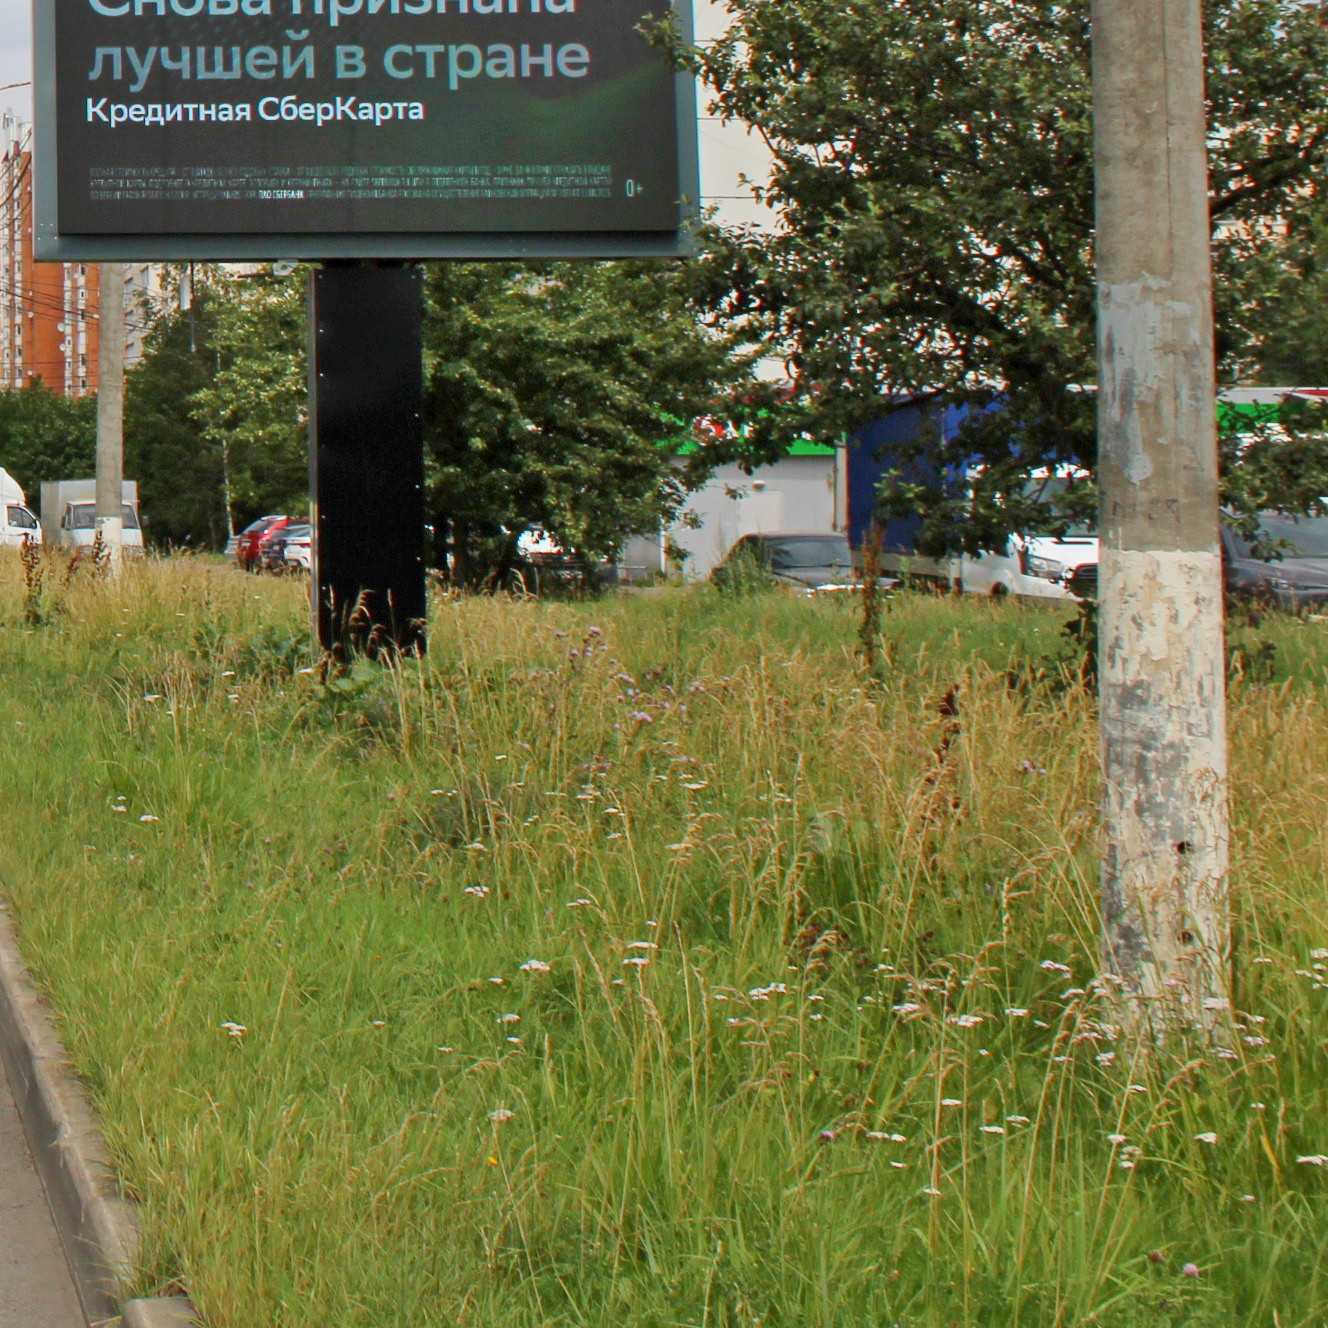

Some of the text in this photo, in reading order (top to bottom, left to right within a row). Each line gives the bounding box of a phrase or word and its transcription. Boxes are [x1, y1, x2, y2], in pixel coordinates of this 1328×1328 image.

[88, 29, 591, 93] лучшей в стране
[86, 94, 425, 128] Кредитная СберКарта
[625, 178, 644, 197] 0+
